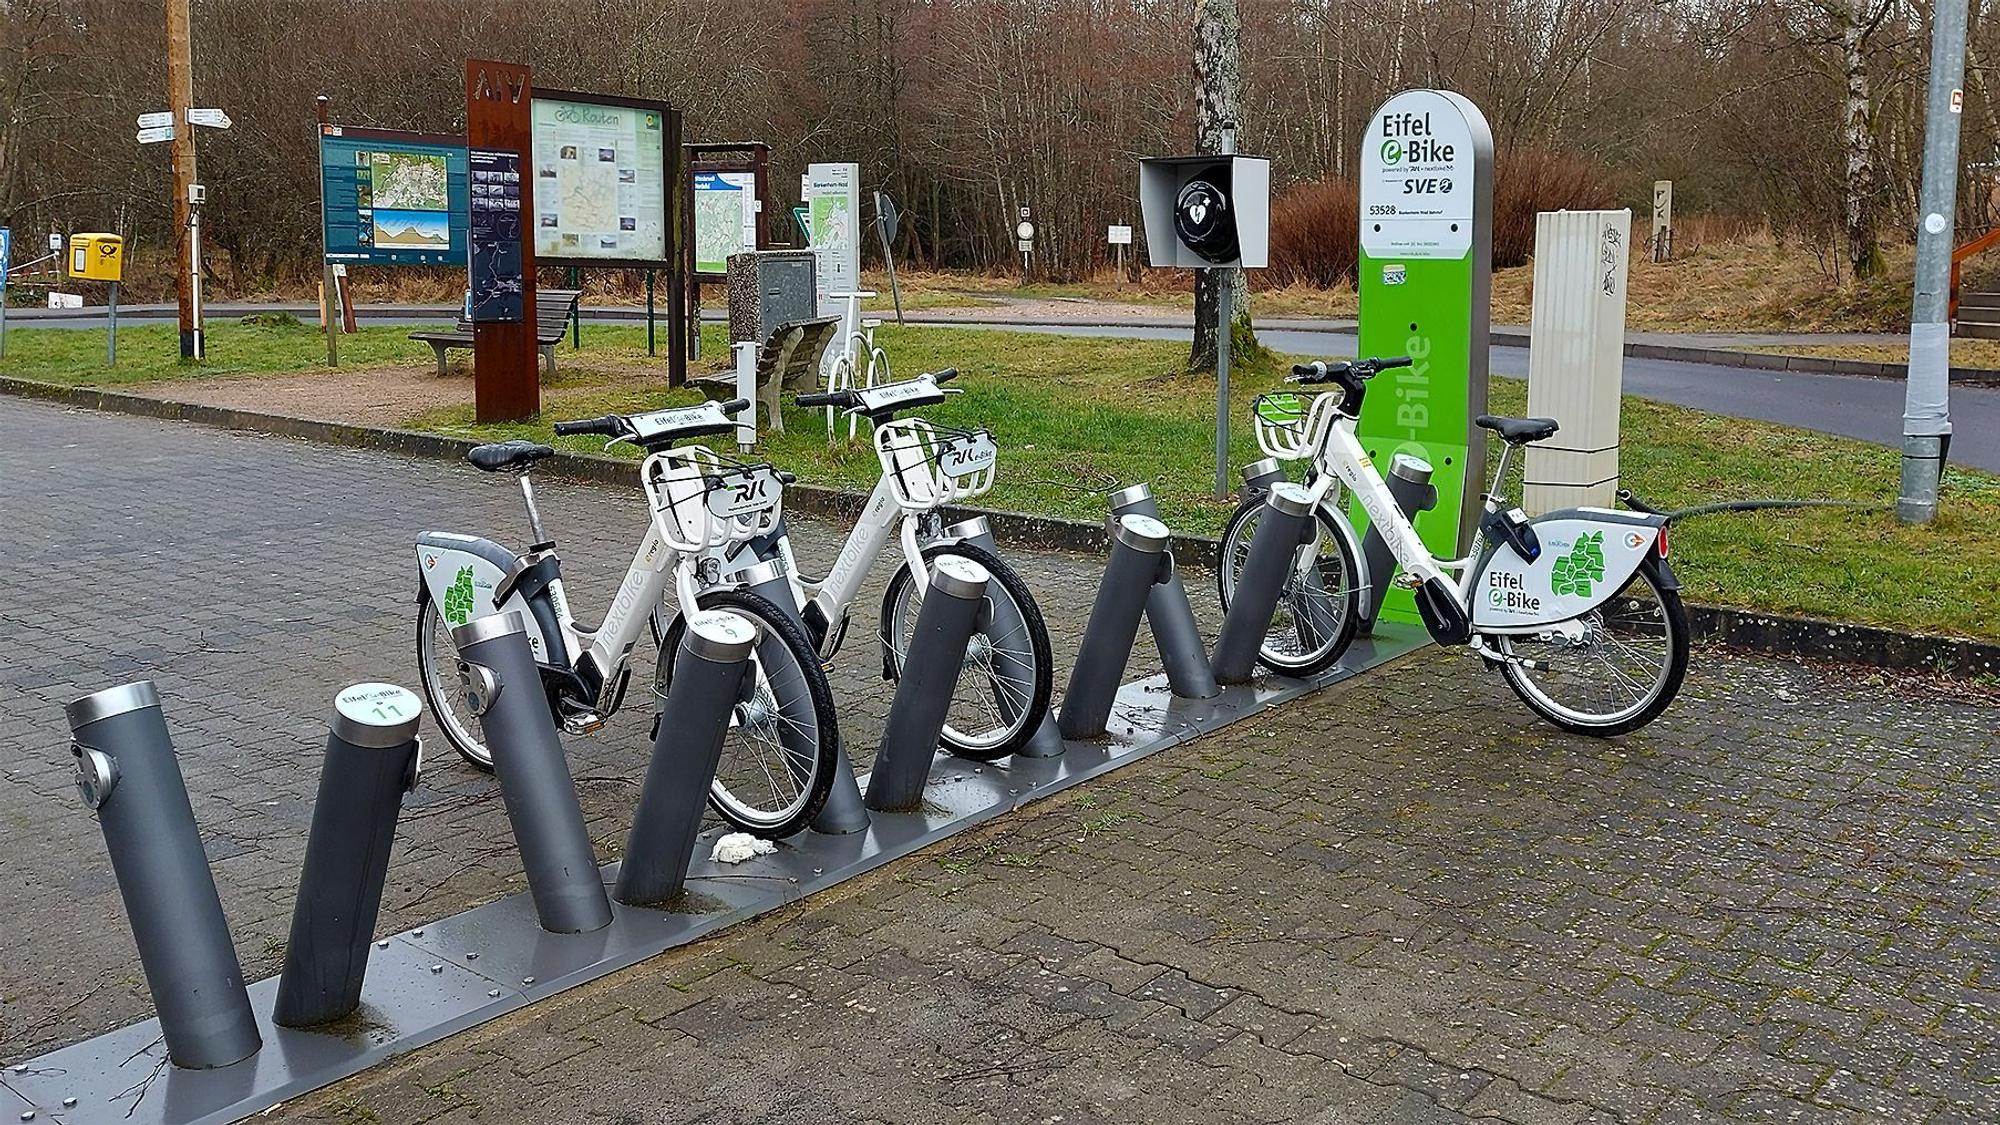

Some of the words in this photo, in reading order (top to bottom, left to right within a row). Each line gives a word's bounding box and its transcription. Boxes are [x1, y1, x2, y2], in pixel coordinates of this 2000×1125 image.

[1383, 111, 1432, 137] Eifel
[1380, 138, 1455, 166] e-Bike
[1403, 178, 1438, 194] SVE
[1369, 204, 1397, 216] 53528
[1490, 572, 1524, 590] Eifel
[1488, 588, 1541, 611] e-Bike
[602, 571, 644, 648] nextbike
[725, 629, 738, 639] 9
[372, 705, 404, 719] 11
